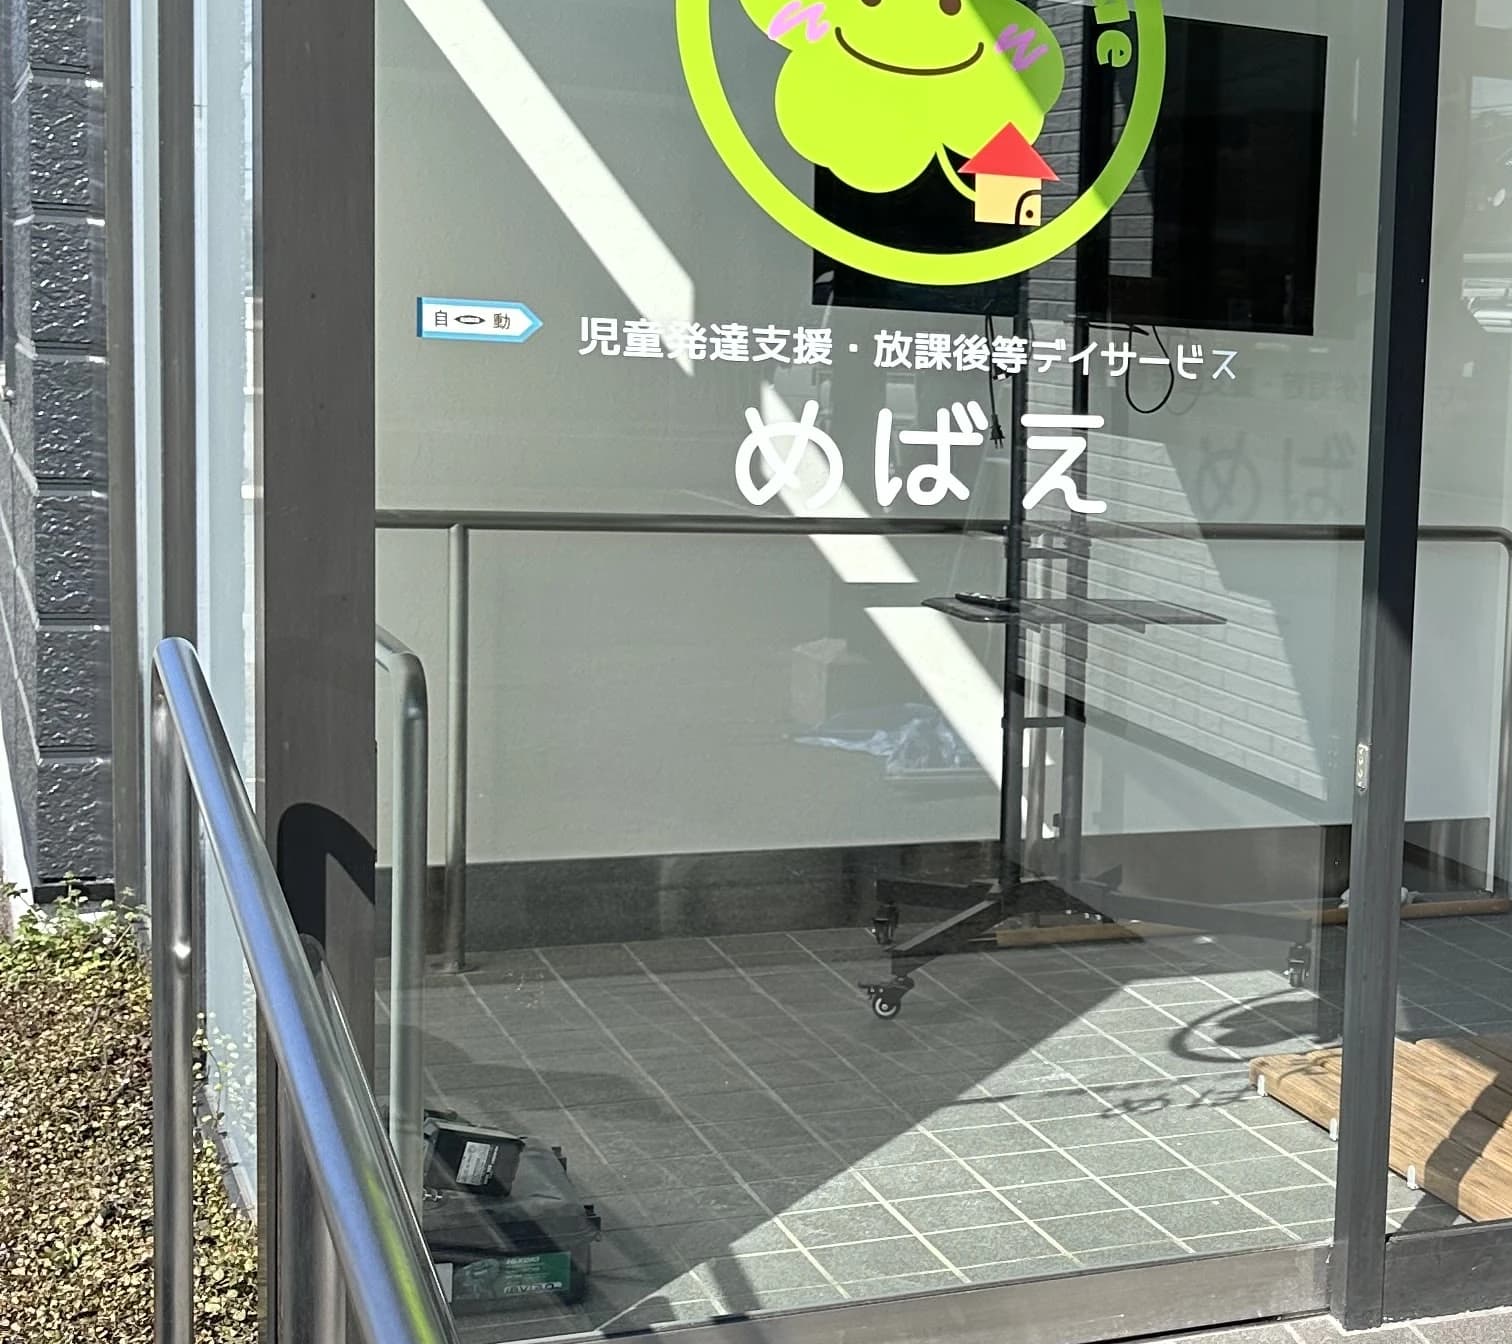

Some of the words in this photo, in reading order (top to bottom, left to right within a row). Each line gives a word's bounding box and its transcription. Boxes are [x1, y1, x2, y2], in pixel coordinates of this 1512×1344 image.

[578, 315, 1241, 381] 児童発達支援・放課後等デイサービス
[735, 398, 1107, 515] めばえ
